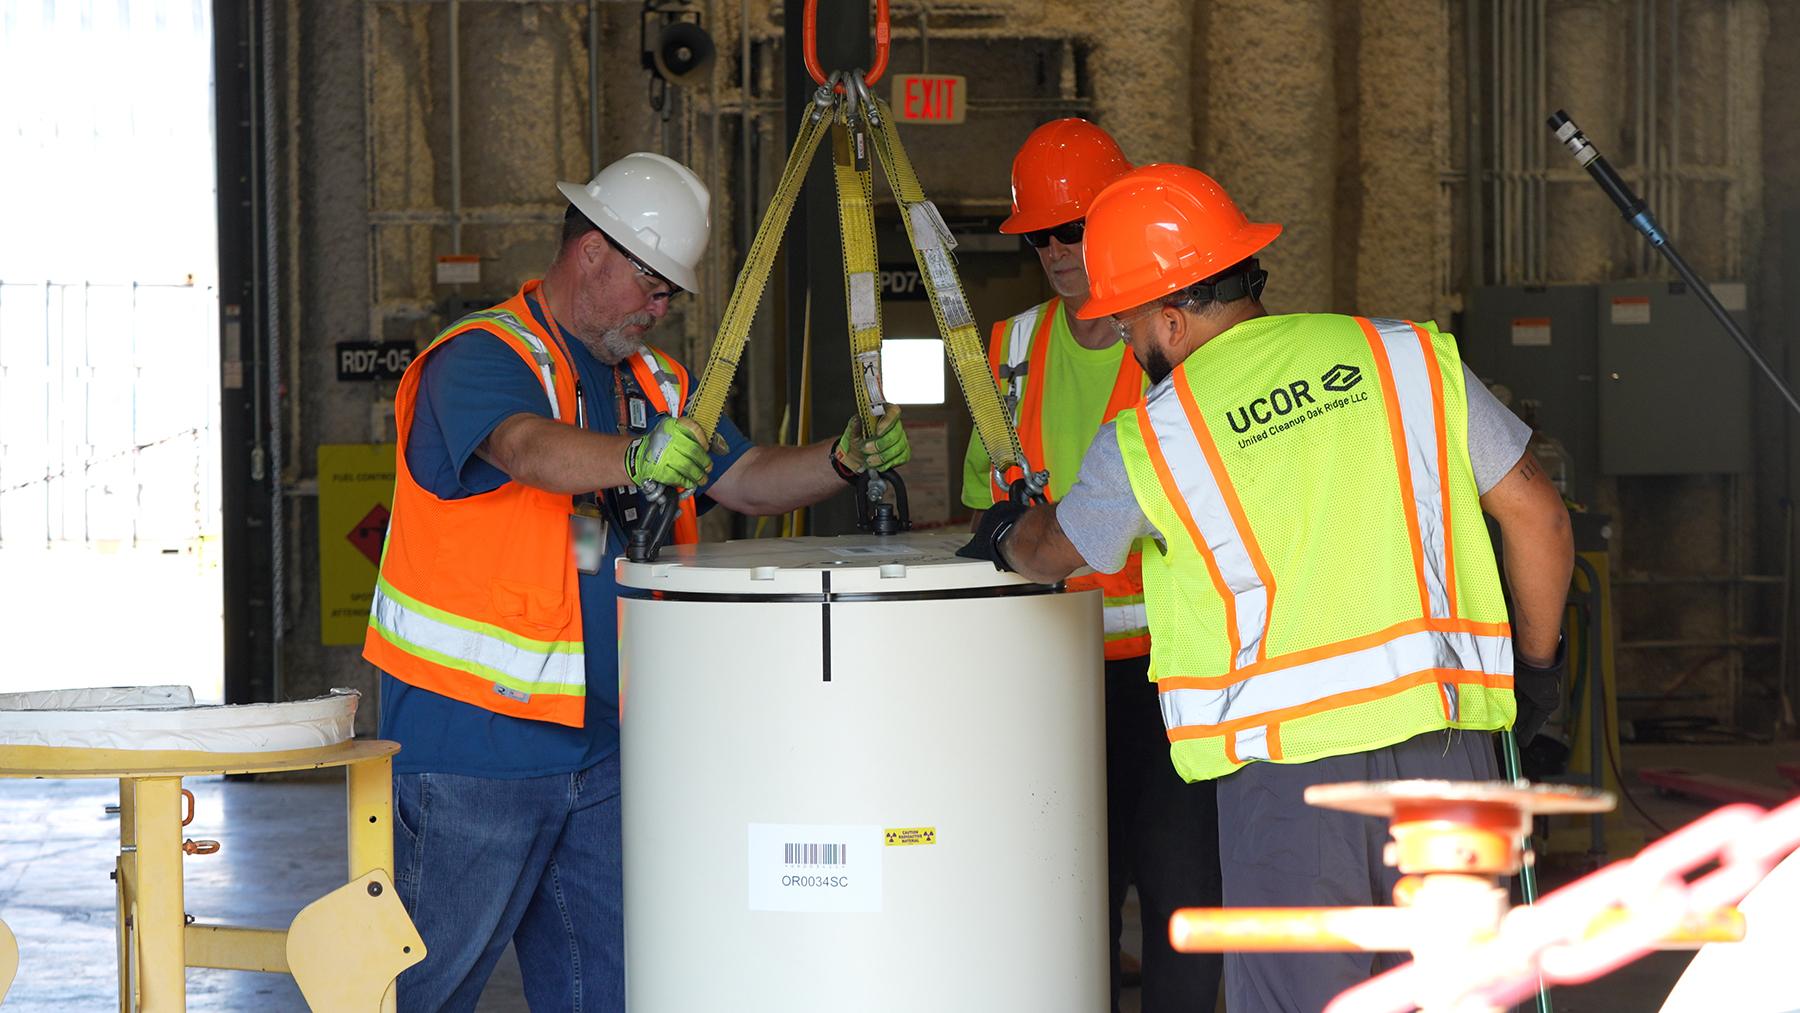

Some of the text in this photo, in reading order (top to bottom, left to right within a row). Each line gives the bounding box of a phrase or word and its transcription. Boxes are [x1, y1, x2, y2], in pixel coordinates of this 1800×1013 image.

[904, 78, 957, 120] EXIT
[879, 271, 924, 293] PD7-
[341, 349, 411, 373] RD7-05
[1226, 380, 1316, 433] UCOR
[1238, 391, 1368, 449] United Cleanup Oak Ridge LLC
[355, 473, 395, 482] CONTRO
[781, 875, 848, 888] OR0034SC
